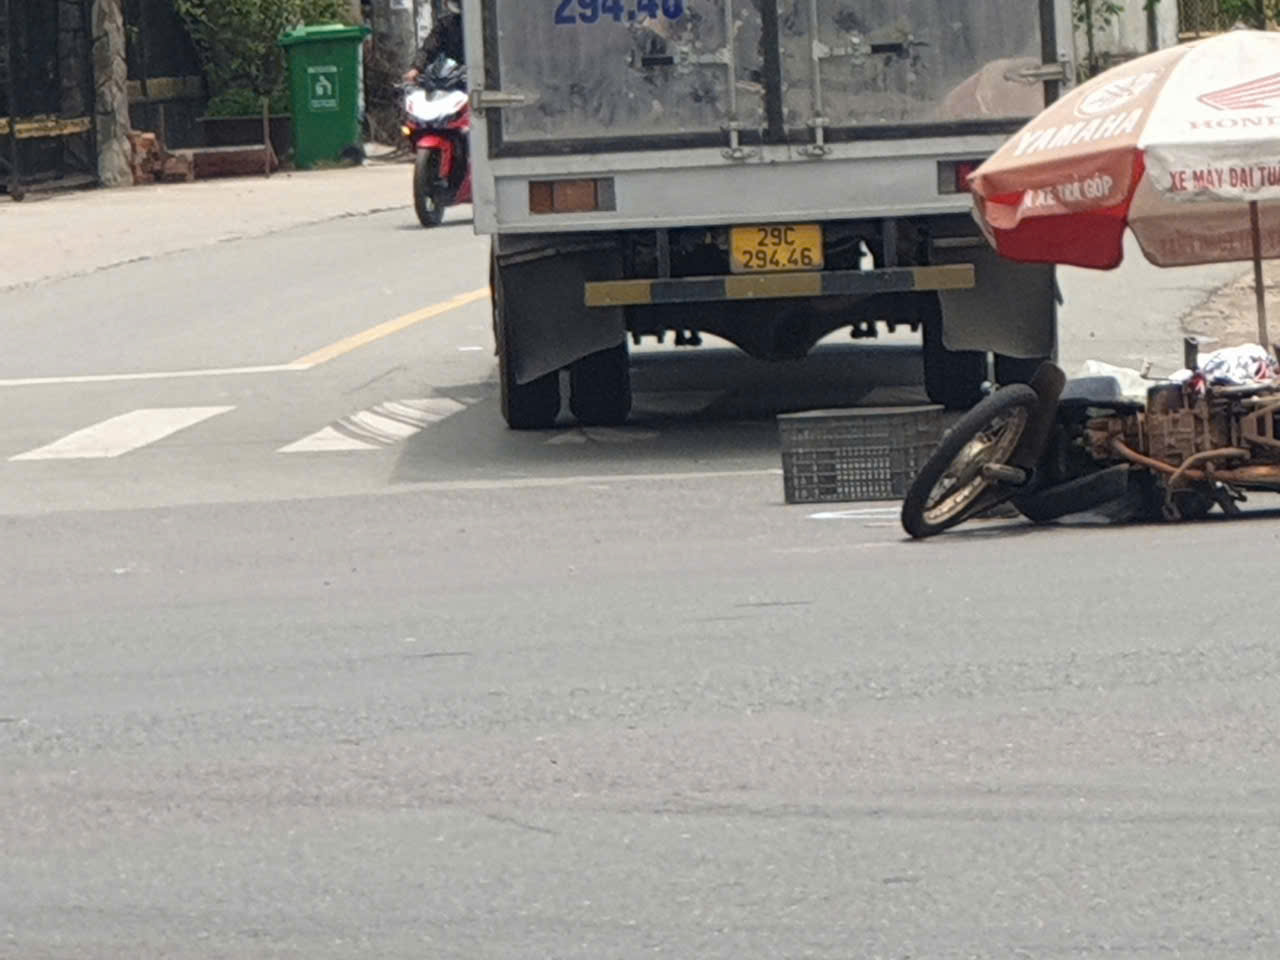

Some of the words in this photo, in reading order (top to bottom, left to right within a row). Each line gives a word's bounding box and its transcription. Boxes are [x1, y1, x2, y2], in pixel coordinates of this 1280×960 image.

[1013, 107, 1145, 157] YAMAHA
[1169, 169, 1188, 192] XE
[756, 226, 796, 247] 29C
[741, 245, 815, 270] 294.46
